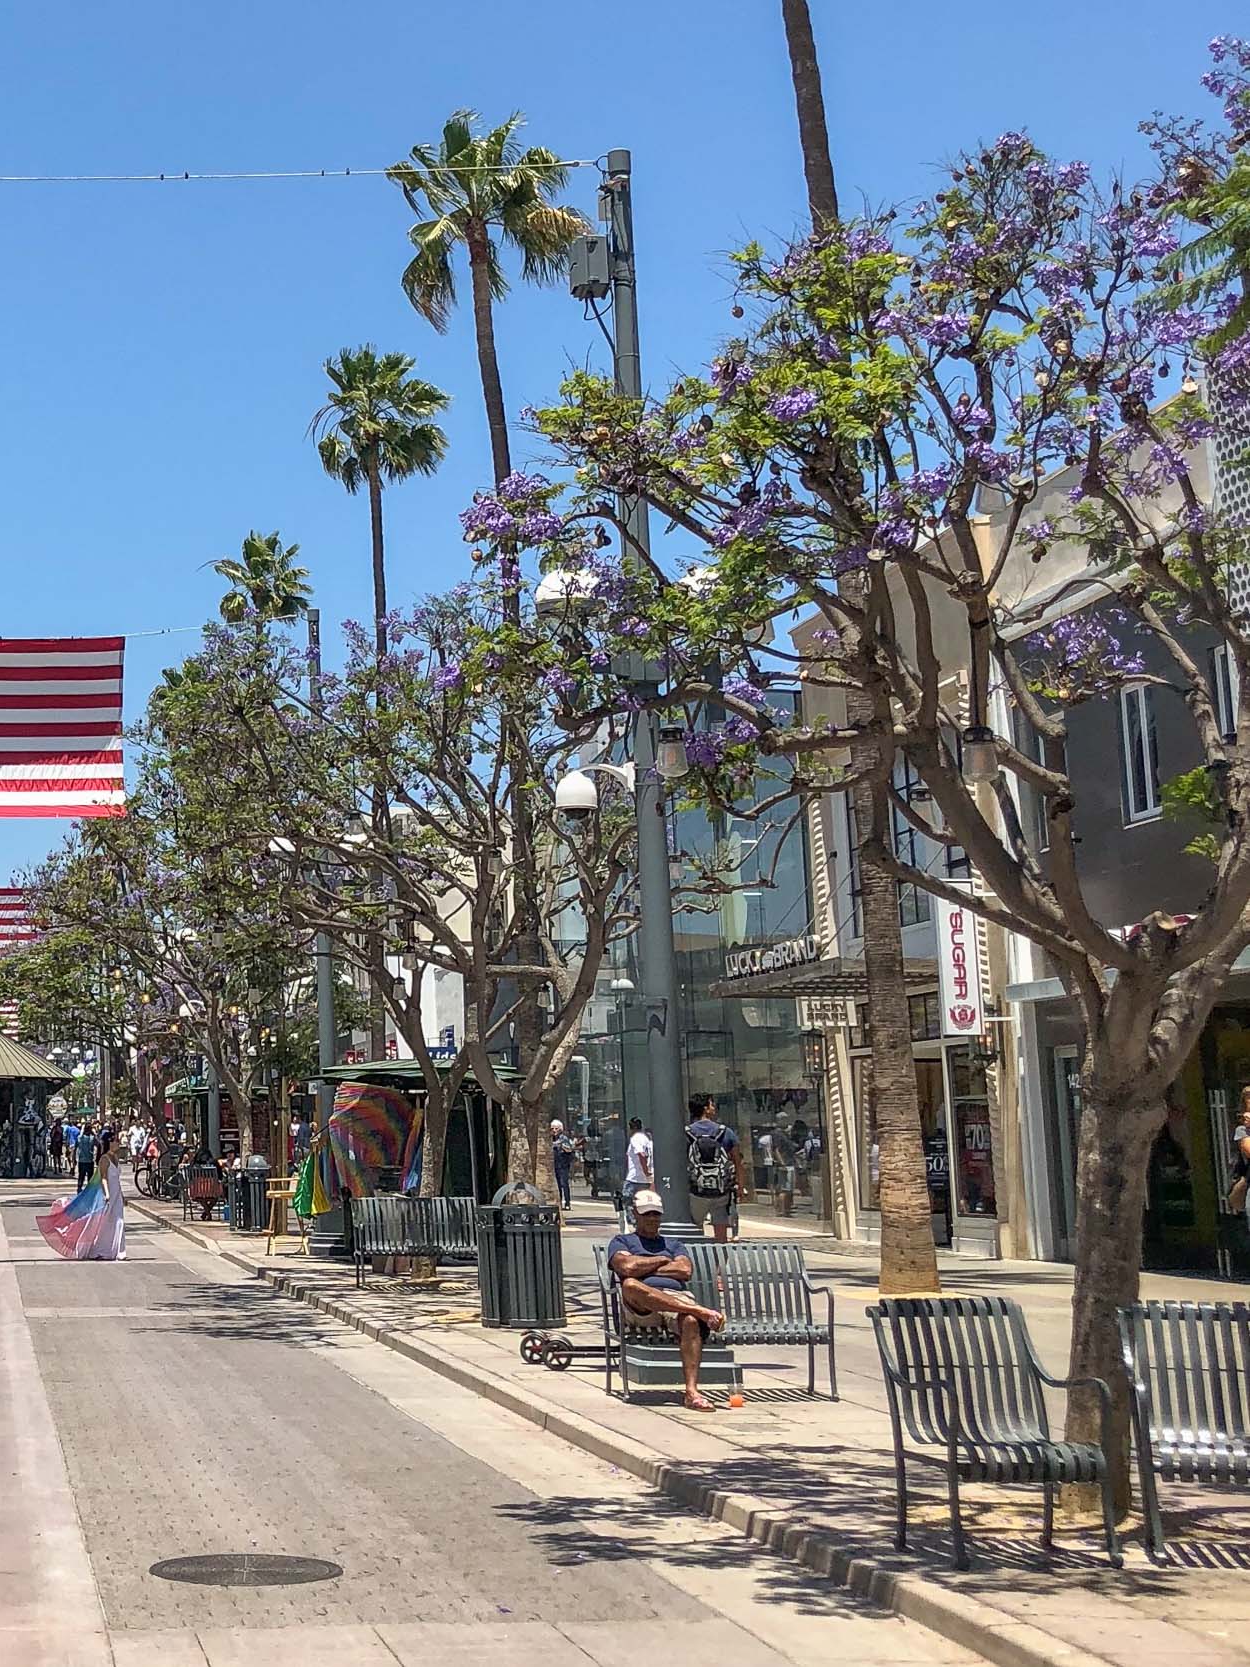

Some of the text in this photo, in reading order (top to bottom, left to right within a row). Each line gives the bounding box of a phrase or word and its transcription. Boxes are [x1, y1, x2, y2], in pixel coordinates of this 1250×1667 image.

[726, 935, 820, 978] LUCKY BRAND
[807, 1001, 847, 1011] LUCKY
[807, 1011, 848, 1022] BRAND
